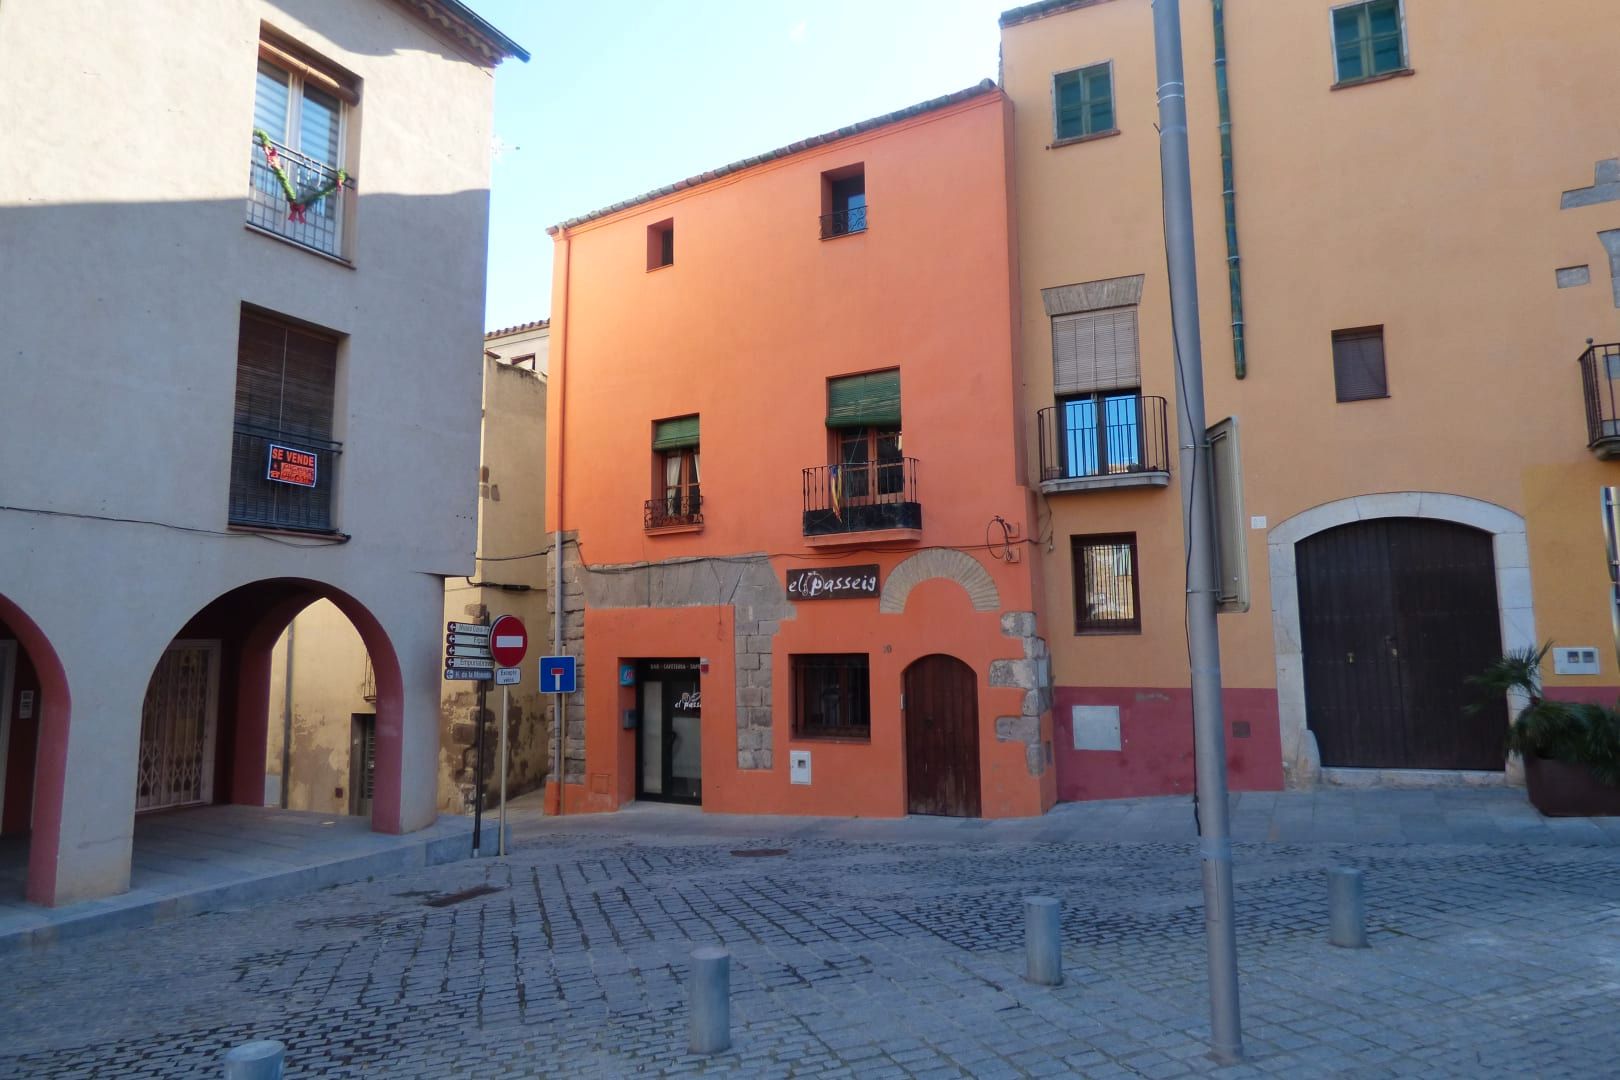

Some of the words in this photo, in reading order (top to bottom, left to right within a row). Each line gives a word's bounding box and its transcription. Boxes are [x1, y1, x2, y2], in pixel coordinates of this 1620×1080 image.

[272, 448, 284, 460] SE
[286, 451, 314, 466] VENDE
[789, 573, 804, 592] el
[810, 575, 877, 596] passeig
